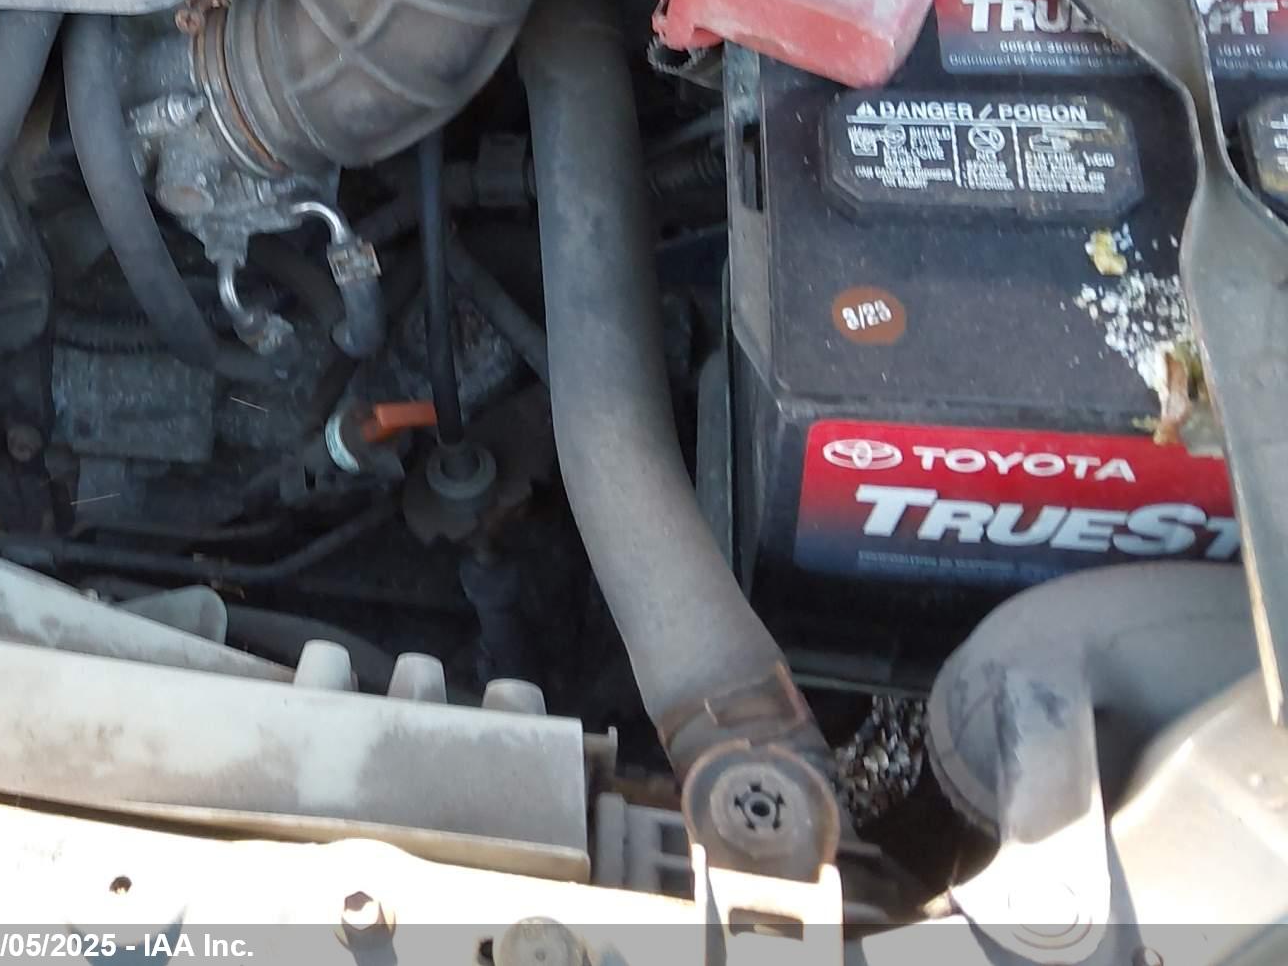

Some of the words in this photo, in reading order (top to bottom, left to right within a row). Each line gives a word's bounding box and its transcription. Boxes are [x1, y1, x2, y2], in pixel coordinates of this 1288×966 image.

[879, 101, 973, 121] DANGER
[998, 104, 1087, 123] POISON
[913, 445, 1136, 483] TOYOTA
[855, 484, 1242, 560] TRUEST
